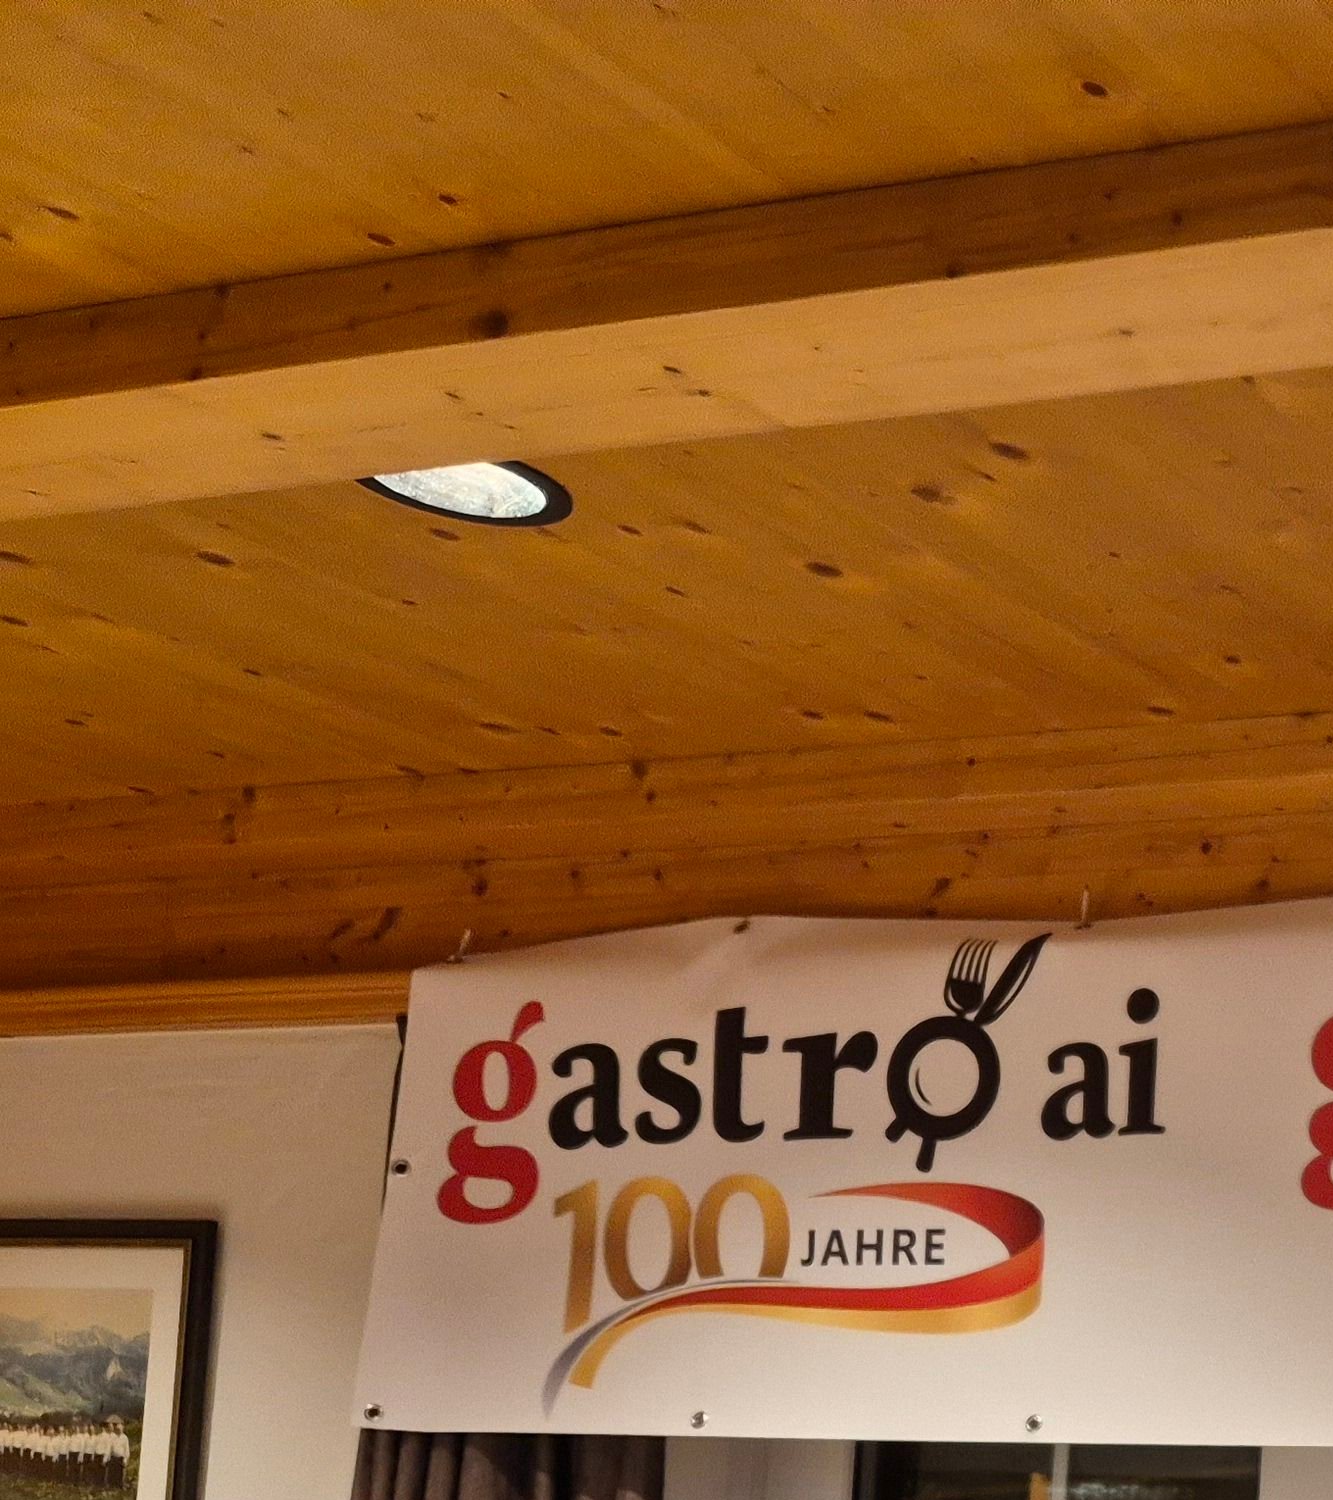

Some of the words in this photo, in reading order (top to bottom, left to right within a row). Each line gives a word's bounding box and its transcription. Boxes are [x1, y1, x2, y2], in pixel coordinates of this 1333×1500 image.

[436, 1000, 1001, 1225] gastro
[1040, 987, 1166, 1141] ai
[552, 1173, 791, 1333] 100
[800, 1228, 946, 1267] JAHRE
